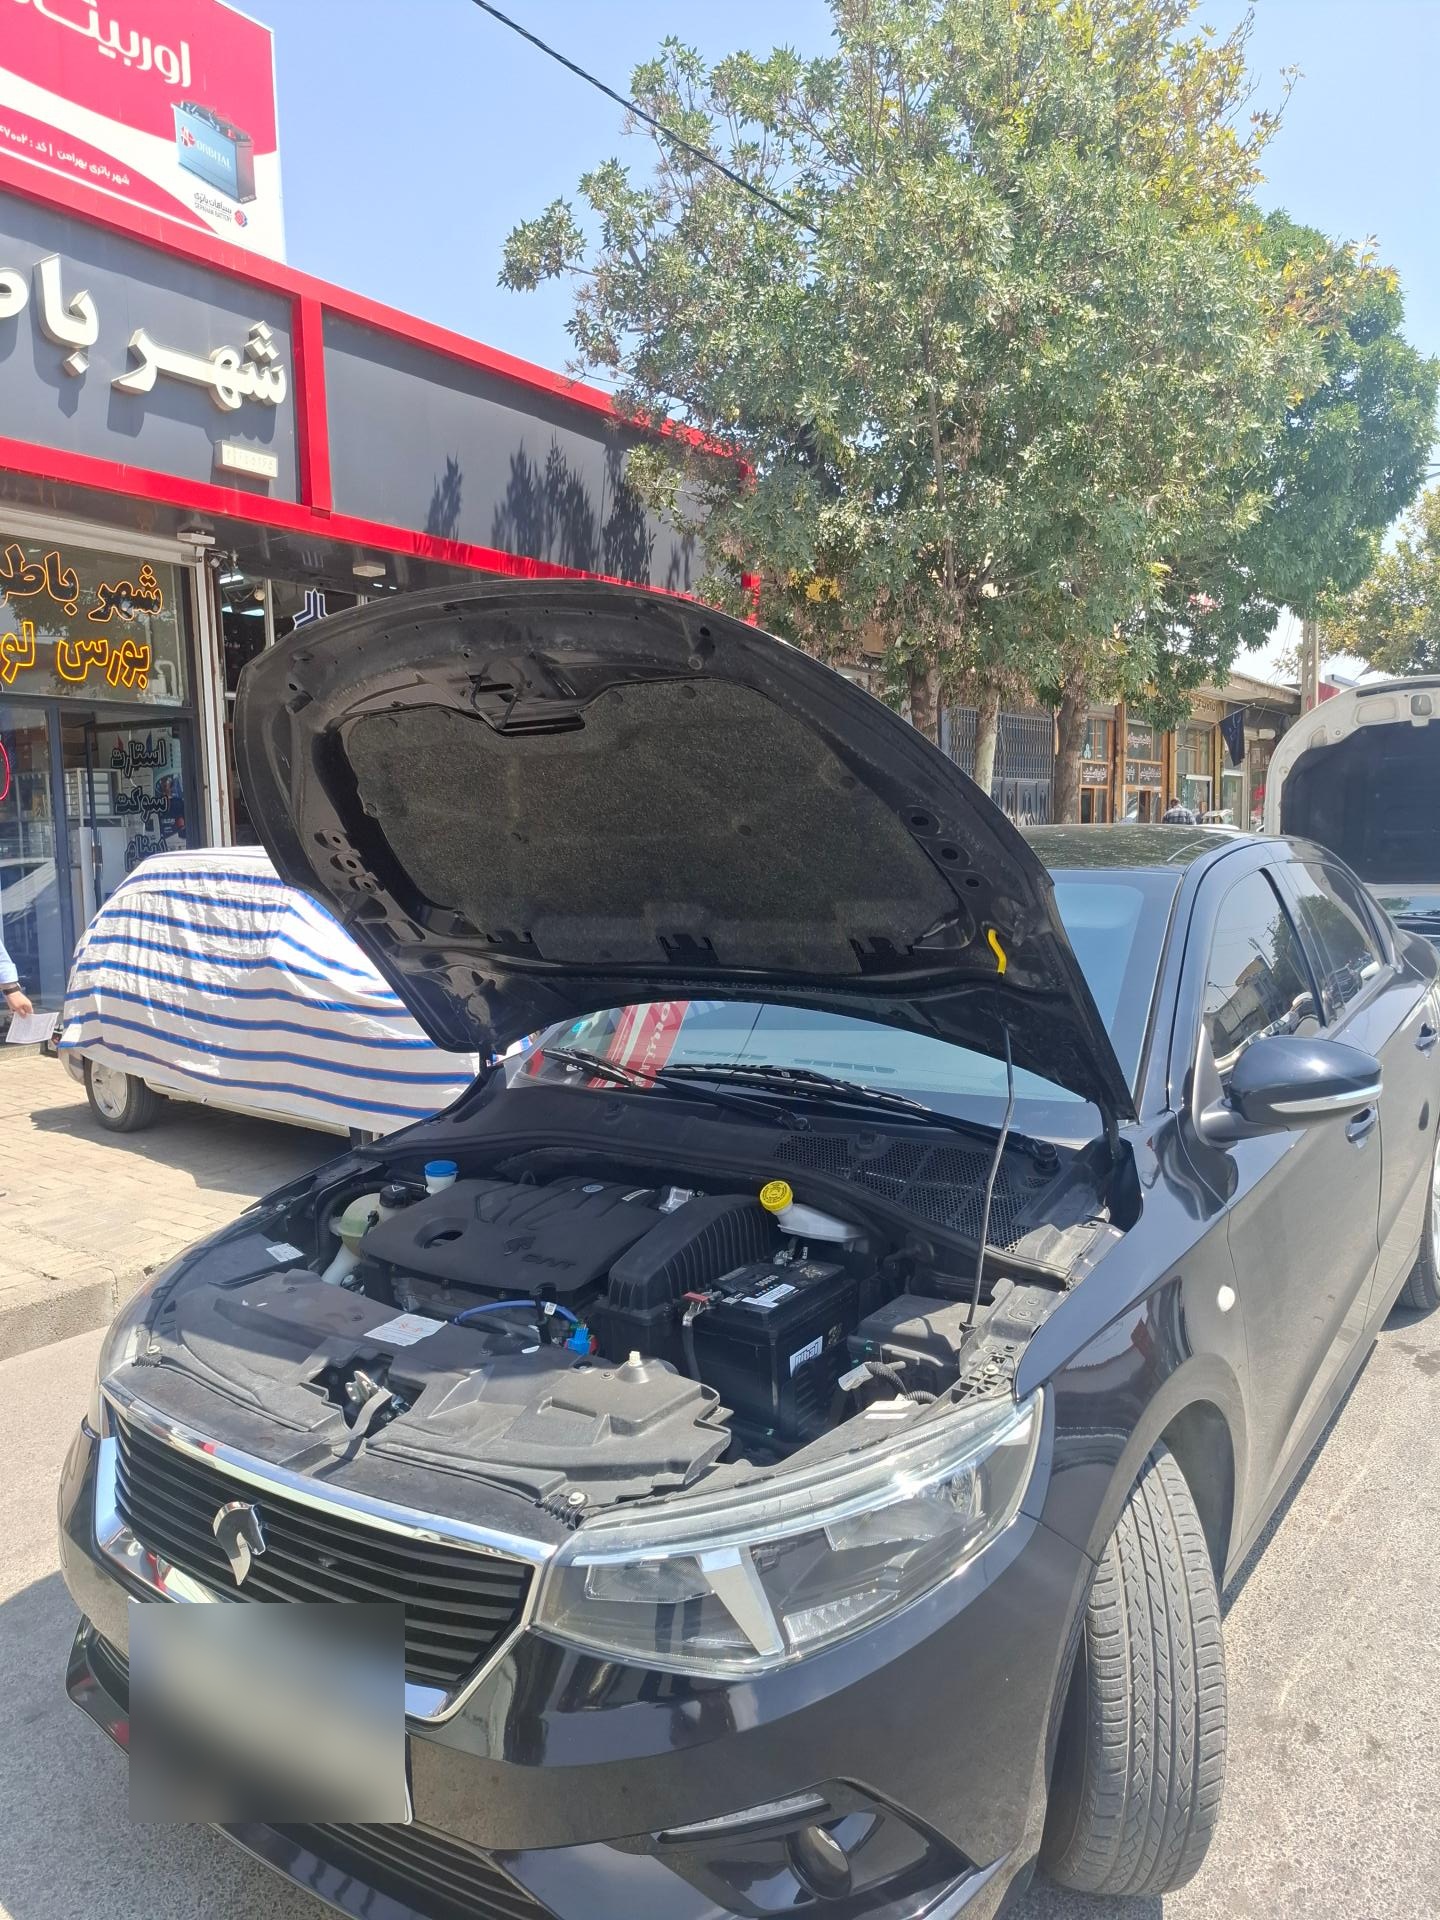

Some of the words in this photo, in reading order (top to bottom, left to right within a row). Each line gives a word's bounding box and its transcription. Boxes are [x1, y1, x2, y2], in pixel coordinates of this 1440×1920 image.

[13, 0, 191, 88] اوربیت
[111, 320, 287, 411] شهر
[0, 543, 79, 617] باط
[88, 565, 163, 622] شهر
[57, 639, 151, 689] بورس
[110, 738, 168, 779] استارت
[114, 786, 169, 823] سوکت
